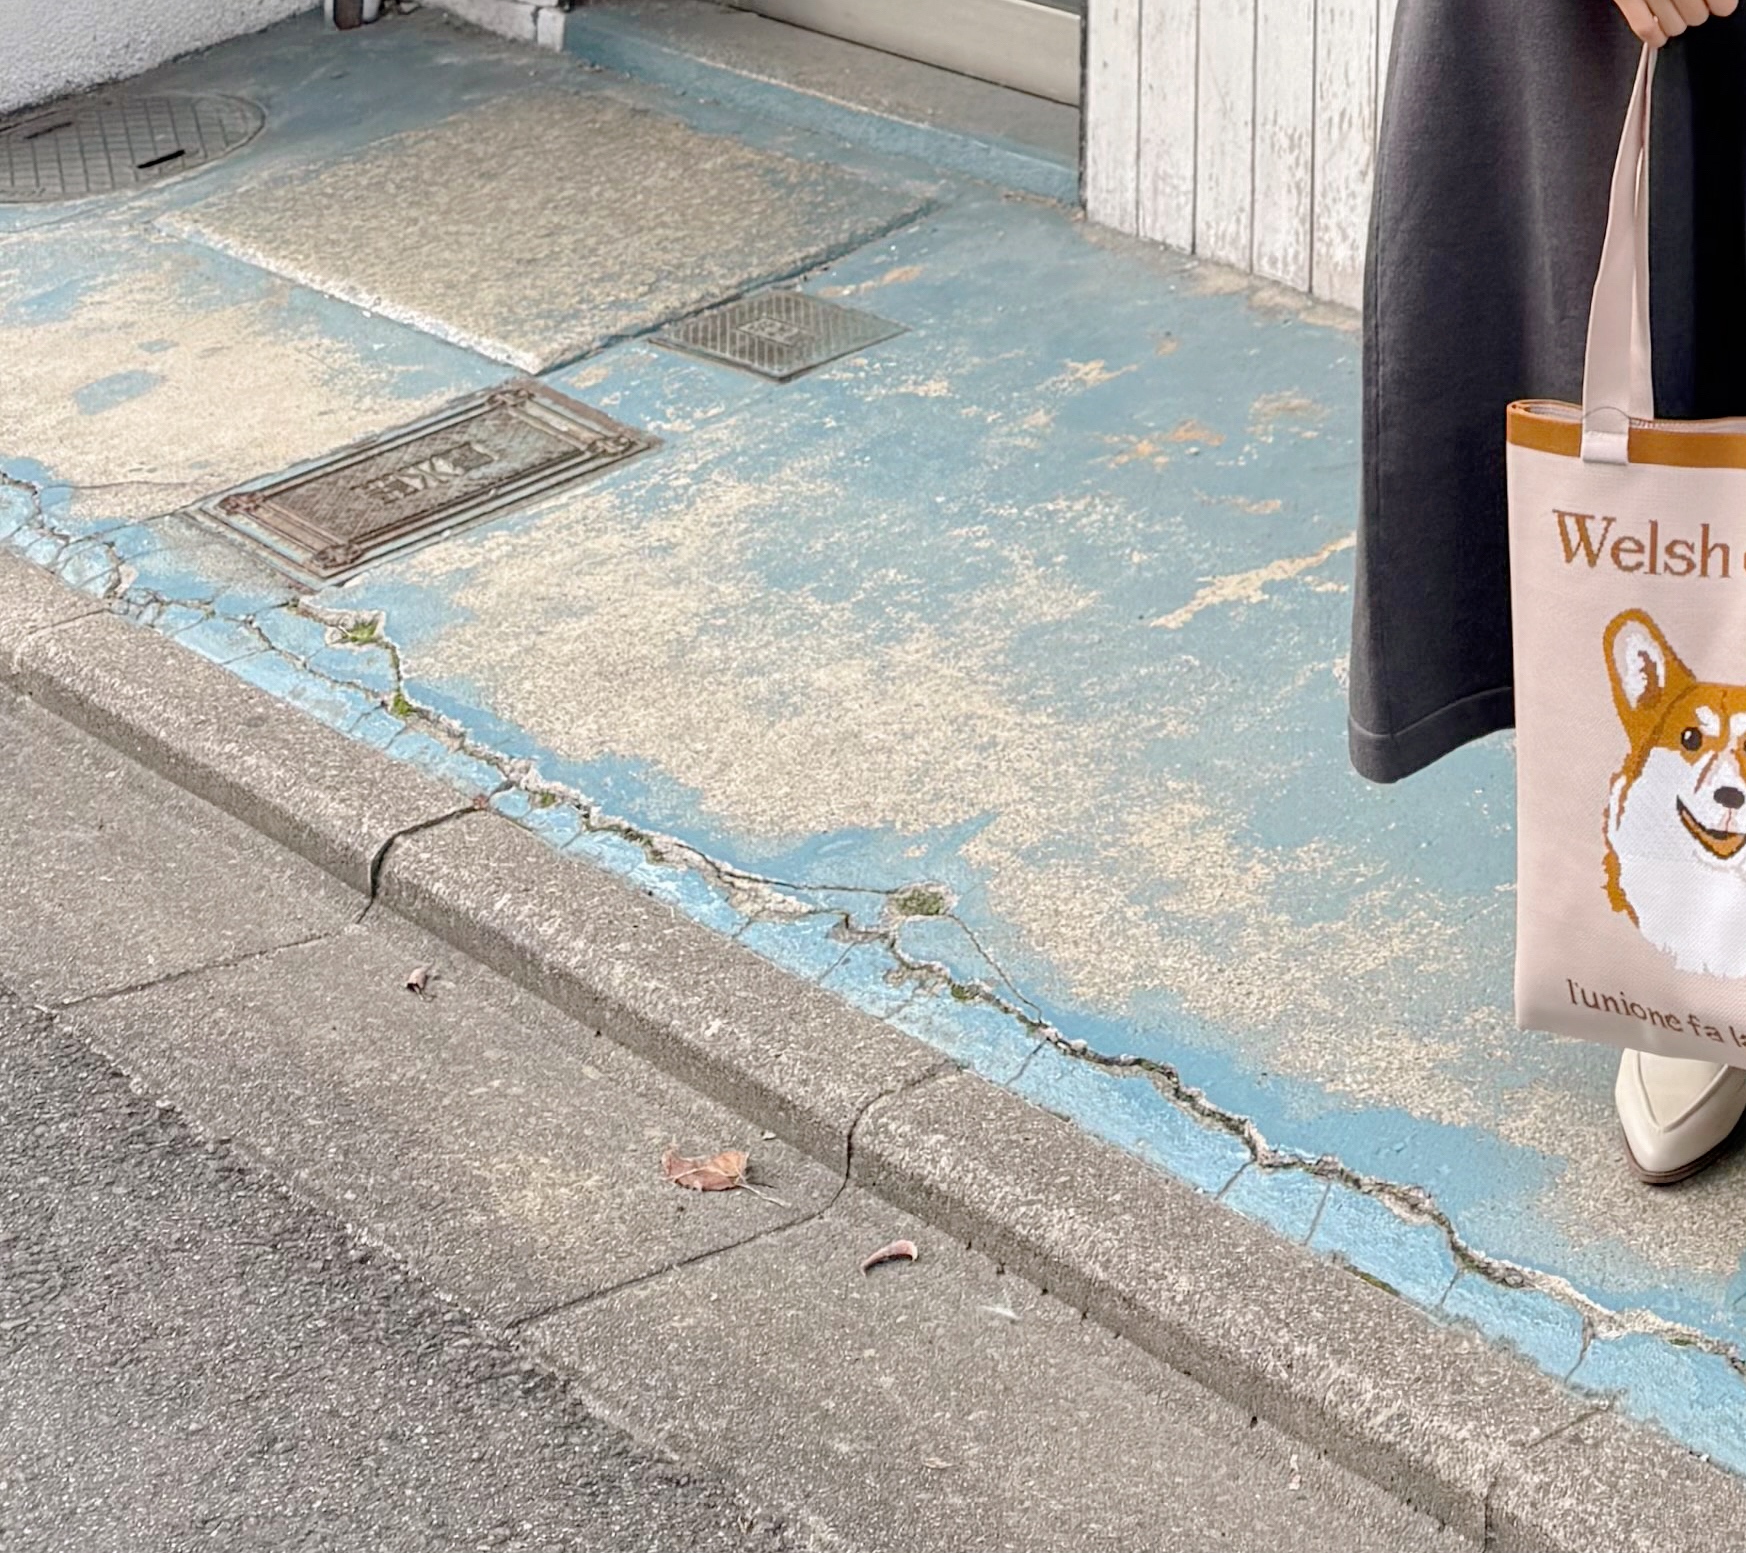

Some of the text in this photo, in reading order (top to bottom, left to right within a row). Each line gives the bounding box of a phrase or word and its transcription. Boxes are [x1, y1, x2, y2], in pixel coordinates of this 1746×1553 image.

[1552, 509, 1732, 579] Welsh
[1566, 978, 1683, 1032] l'unione
[1687, 1013, 1724, 1043] fa
